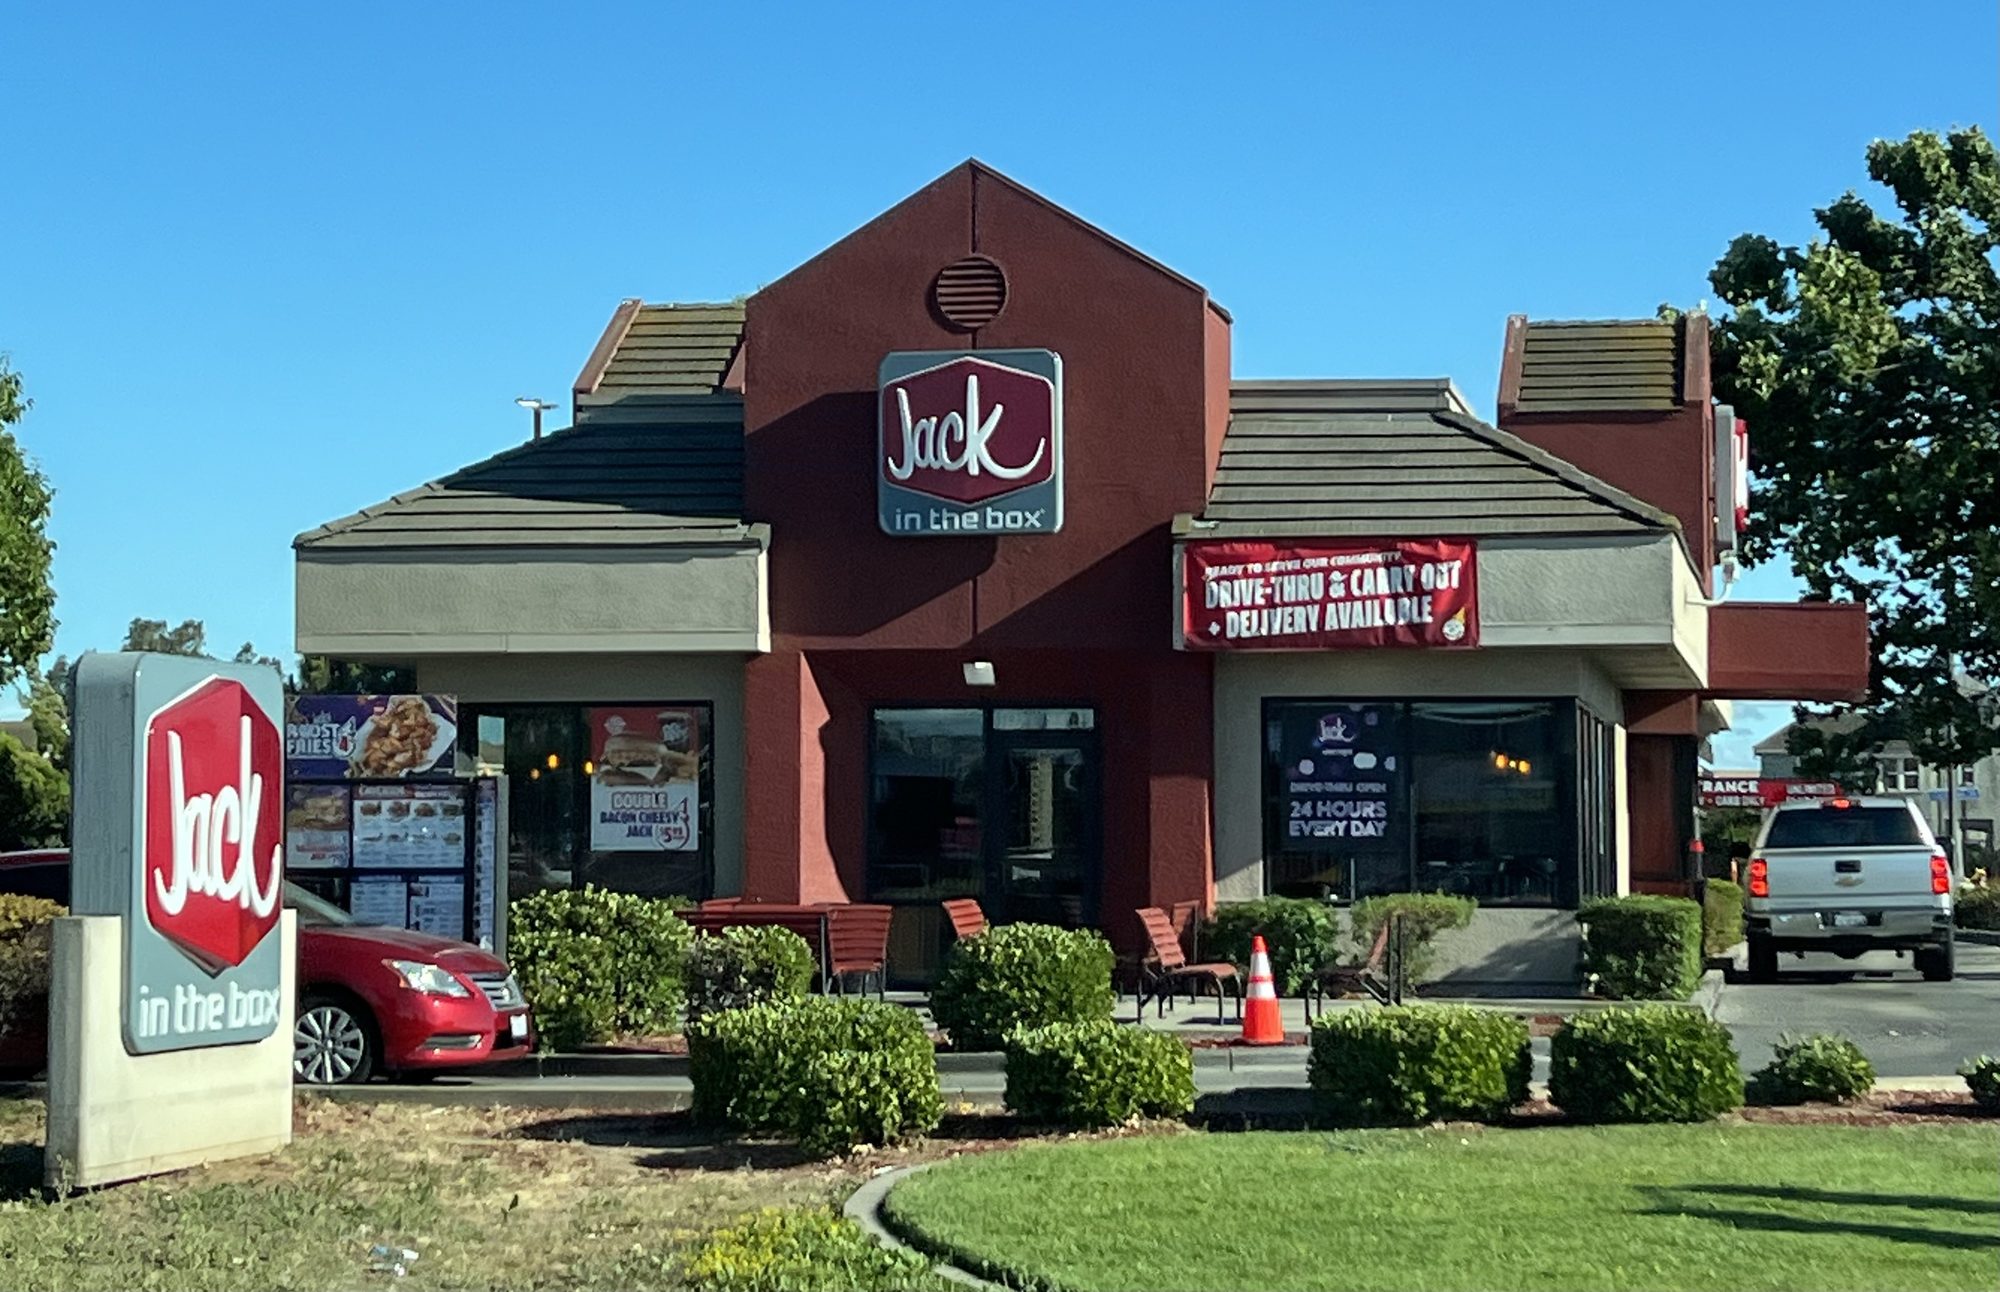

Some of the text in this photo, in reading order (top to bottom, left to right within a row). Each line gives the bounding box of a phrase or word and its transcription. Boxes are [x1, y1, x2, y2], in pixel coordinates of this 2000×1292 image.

[888, 374, 1046, 481] Jack
[895, 507, 1041, 530] in the box
[1205, 560, 1461, 609] DRIVE-THRU & CARRY OUT
[1226, 604, 1319, 639] DELIVERY
[1325, 595, 1433, 631] AVAILABLE
[1698, 780, 1759, 794] RANCE
[154, 715, 281, 918] Jack
[600, 811, 637, 823] BACON
[1290, 800, 1387, 818] 24 HOURS
[626, 825, 653, 837] JACK
[1289, 820, 1387, 837] EVERY DAY
[139, 981, 280, 1038] in the box
